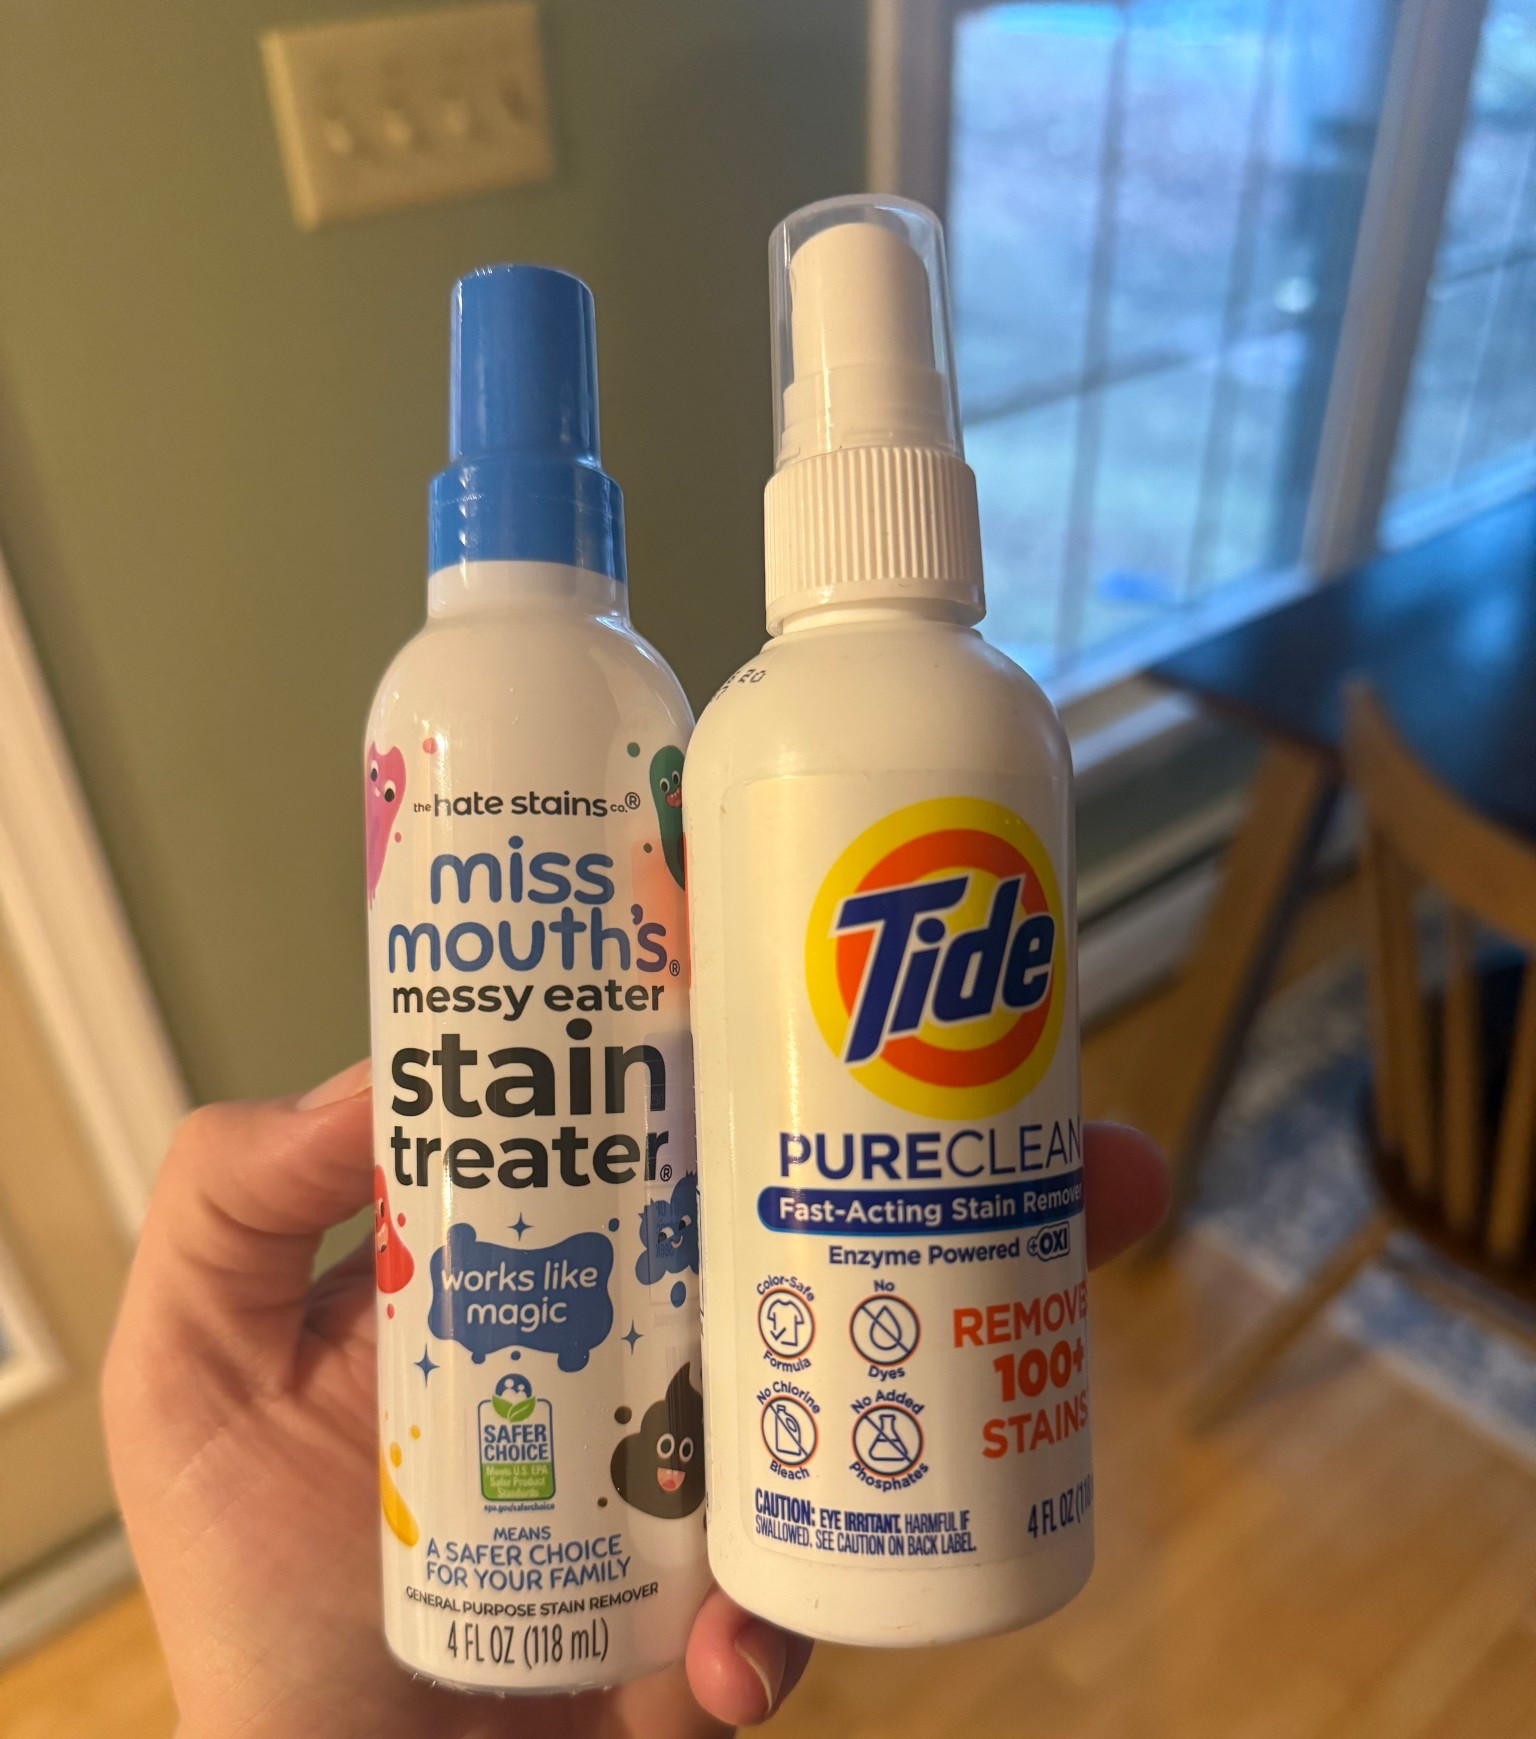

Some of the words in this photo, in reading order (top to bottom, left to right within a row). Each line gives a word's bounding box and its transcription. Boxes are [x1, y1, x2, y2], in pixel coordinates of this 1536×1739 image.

[414, 802, 431, 813] the
[434, 791, 503, 817] hate
[511, 790, 608, 817] stains
[430, 835, 615, 905] miss
[832, 872, 1056, 1066] Tide
[392, 985, 534, 1021] messy
[544, 979, 665, 1012] eater
[391, 1018, 666, 1118] stain
[779, 1196, 943, 1227] Fast-Acting
[951, 1194, 1016, 1221] Stain
[828, 1244, 921, 1269] Enzyme
[928, 1237, 1020, 1265] Powered
[441, 1261, 535, 1293] works
[544, 1259, 599, 1291] like
[756, 1274, 815, 1302] Color-Safe
[873, 1278, 896, 1293] No
[467, 1296, 568, 1333] magic
[763, 1350, 813, 1373] Formula
[868, 1364, 906, 1382] Dyes
[993, 1337, 1084, 1402] 100+
[756, 1387, 772, 1405] No
[772, 1380, 821, 1415] Chlorine
[850, 1395, 872, 1414] No
[875, 1389, 925, 1415] Added
[483, 1423, 548, 1444] SAFER
[483, 1443, 549, 1462] CHOICE
[486, 1465, 511, 1476] Meets
[531, 1464, 549, 1475] EPA
[490, 1476, 511, 1487] Safer
[513, 1476, 546, 1487] Product
[770, 1459, 810, 1481] Bleach
[849, 1462, 929, 1493] Phosphates
[755, 1487, 815, 1527] CAUTION:
[819, 1508, 842, 1530] EYE
[905, 1510, 957, 1533] HARMFUL
[960, 1510, 970, 1531] IF
[1028, 1504, 1038, 1539] 4
[1042, 1497, 1057, 1535] FL
[1059, 1487, 1074, 1527] OZ
[493, 1525, 552, 1542] MEANS
[815, 1530, 835, 1552] SEE
[837, 1531, 885, 1556] CAUTION
[888, 1535, 905, 1556] ON
[907, 1534, 938, 1556] BACK
[941, 1532, 977, 1555] LABEL.
[426, 1537, 441, 1560] A
[446, 1541, 523, 1567] SAFER
[529, 1533, 623, 1566] CHOICE
[426, 1561, 469, 1589] FOR
[473, 1567, 543, 1592] YOUR
[550, 1555, 632, 1589] FAMILY
[405, 1585, 462, 1613] GENERAL
[462, 1600, 537, 1618] PURPOSE
[540, 1599, 586, 1617] STAIN
[589, 1581, 659, 1610] REMOVER
[447, 1619, 458, 1659] 4
[464, 1622, 485, 1663] FL
[490, 1624, 516, 1665] OZ
[523, 1623, 563, 1670] (118
[571, 1616, 610, 1663] mL)
